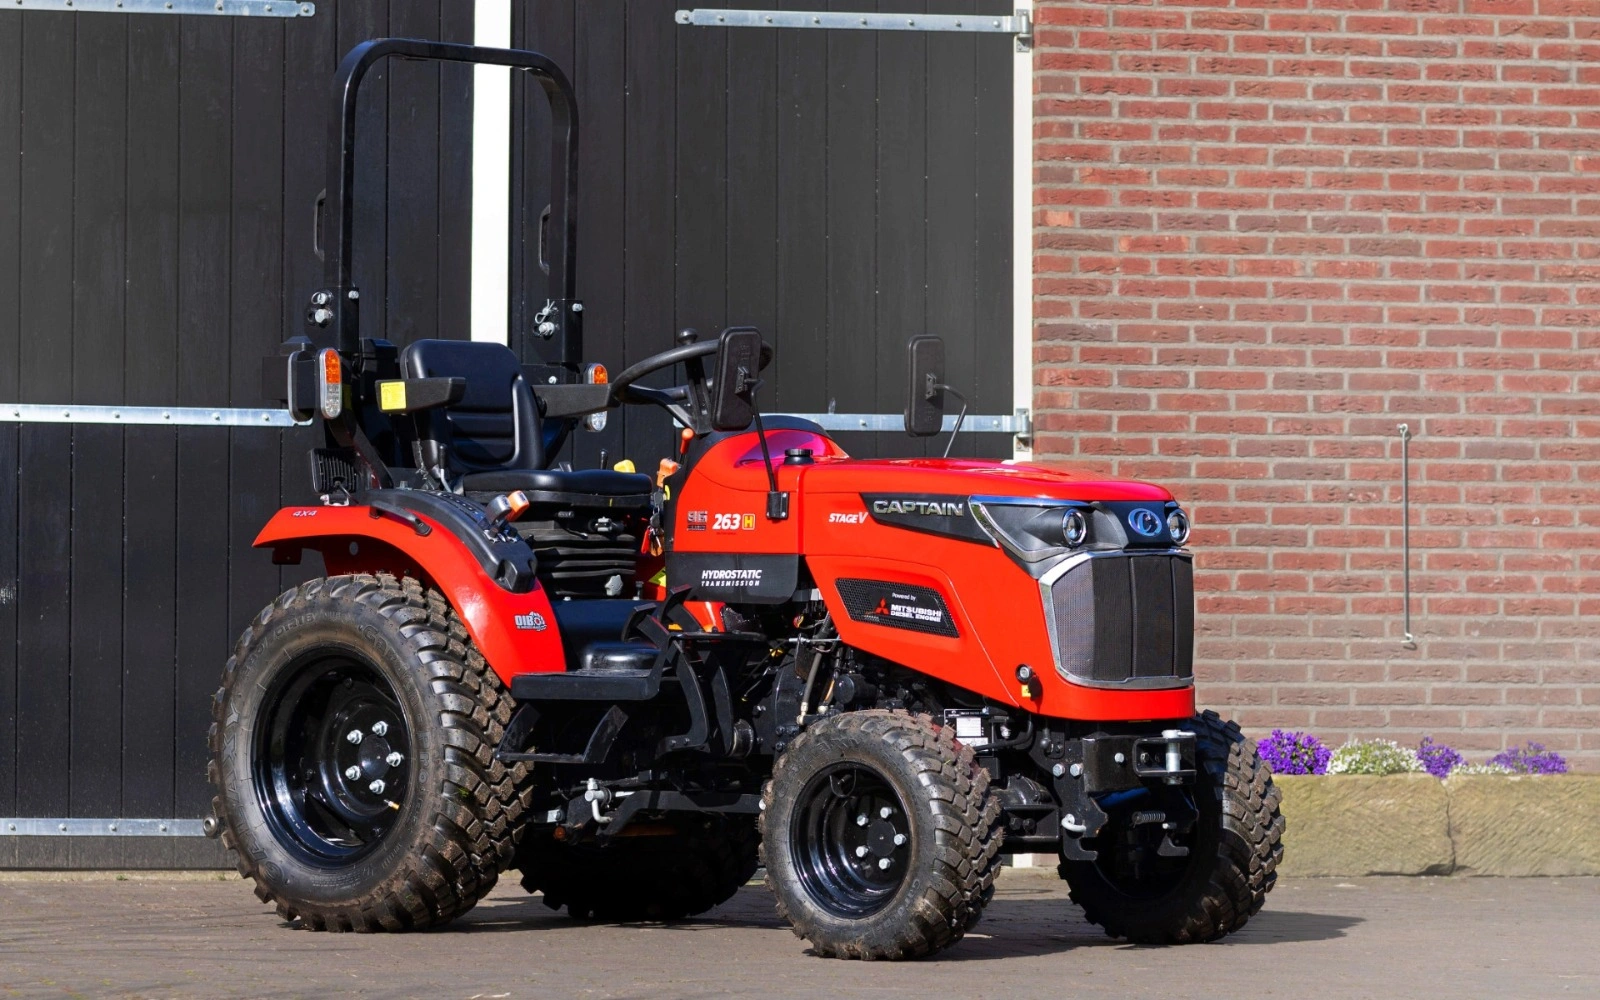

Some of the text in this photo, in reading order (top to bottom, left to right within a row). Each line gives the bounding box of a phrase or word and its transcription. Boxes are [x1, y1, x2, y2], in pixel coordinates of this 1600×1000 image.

[873, 500, 964, 516] CAPTAIN
[712, 514, 741, 530] 263
[743, 514, 754, 529] H
[828, 512, 868, 524] STAGE V
[702, 570, 762, 579] HYDROSTATIC
[890, 604, 942, 616] MITSUBISHI
[890, 610, 942, 622] DIESEL ENGINE
